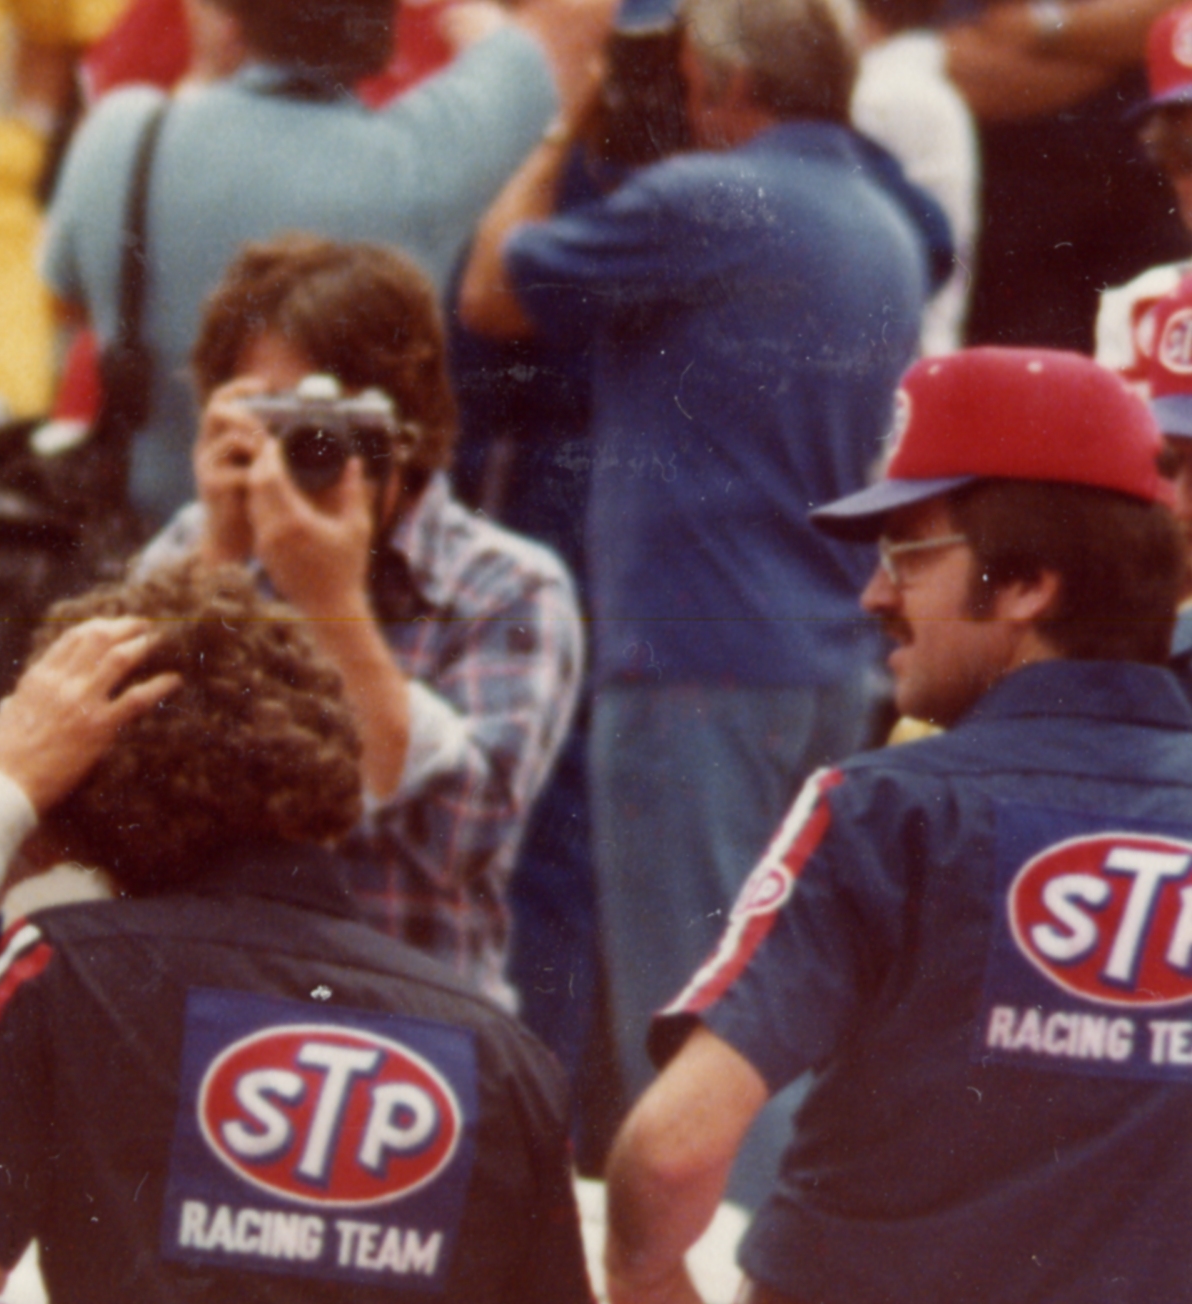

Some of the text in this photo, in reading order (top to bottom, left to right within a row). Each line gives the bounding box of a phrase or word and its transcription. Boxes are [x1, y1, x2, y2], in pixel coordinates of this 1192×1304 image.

[986, 1005, 1135, 1061] RACING
[220, 1042, 438, 1182] STP
[178, 1200, 445, 1276] RACING TEAM
